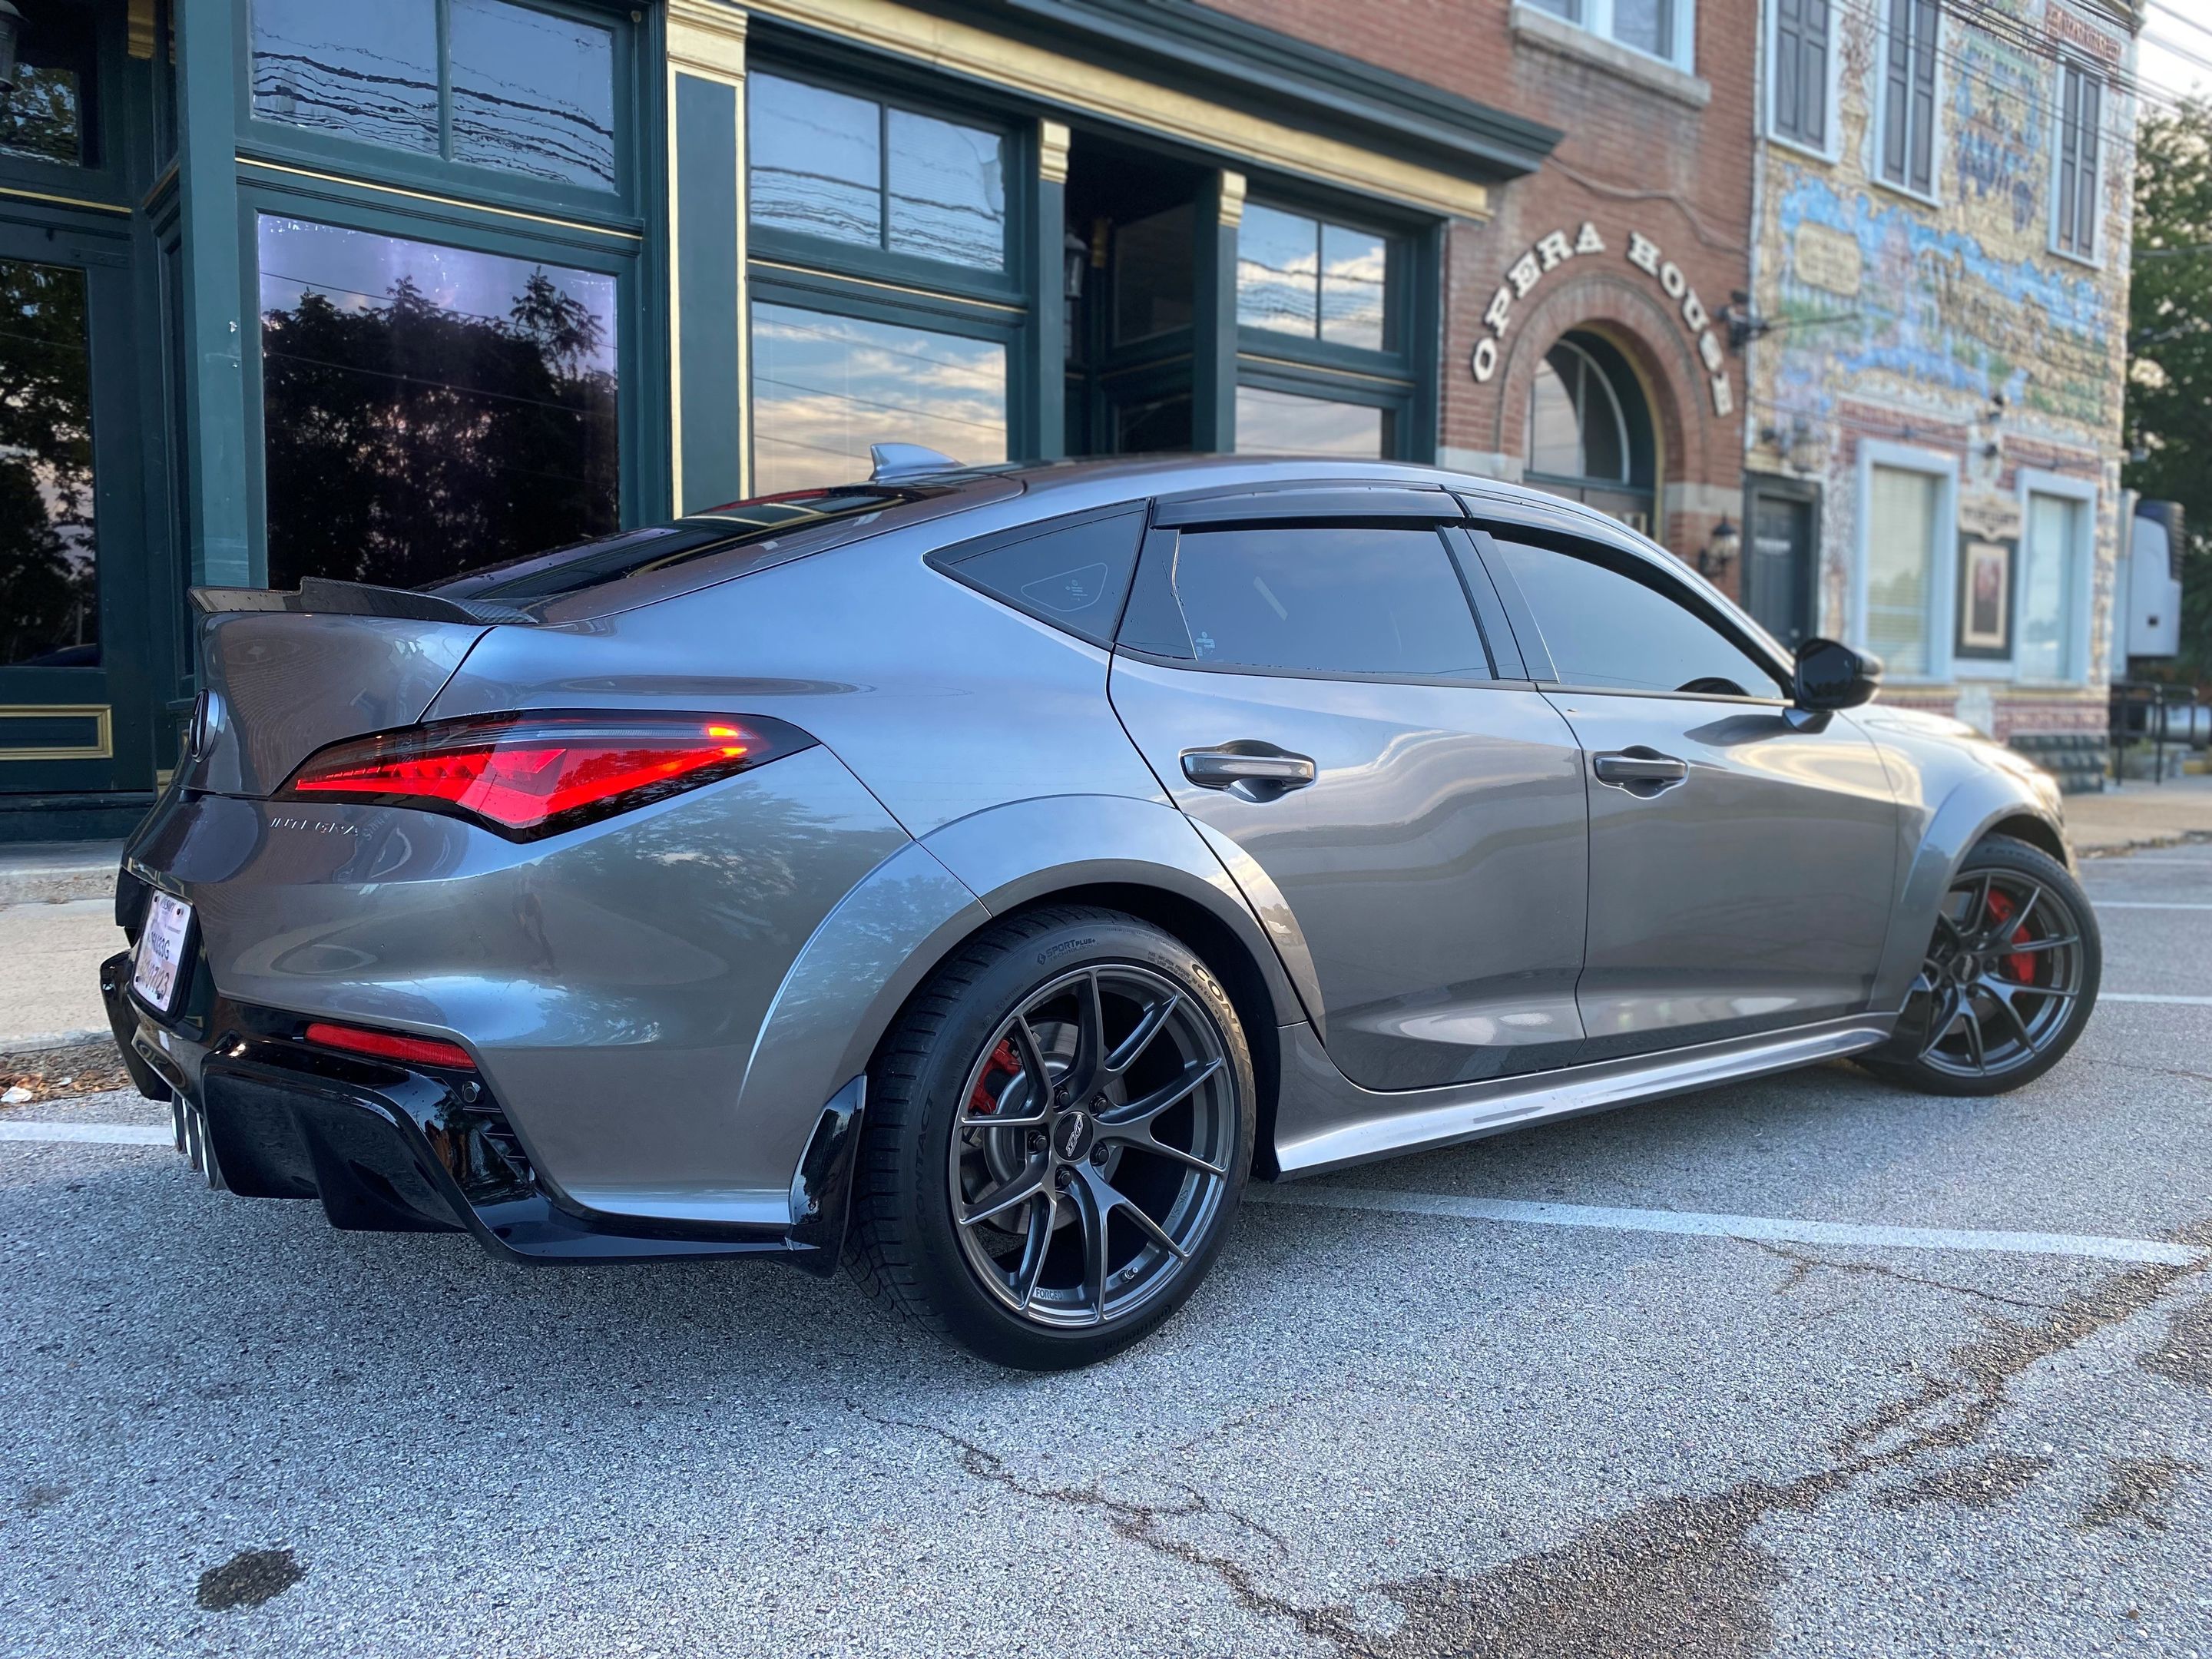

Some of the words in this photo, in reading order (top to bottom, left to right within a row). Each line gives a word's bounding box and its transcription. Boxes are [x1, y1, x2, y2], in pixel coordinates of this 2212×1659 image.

[1472, 220, 1605, 382] OPERA
[1627, 231, 1734, 418] HOUSE
[1035, 1288, 1064, 1300] FORGED
